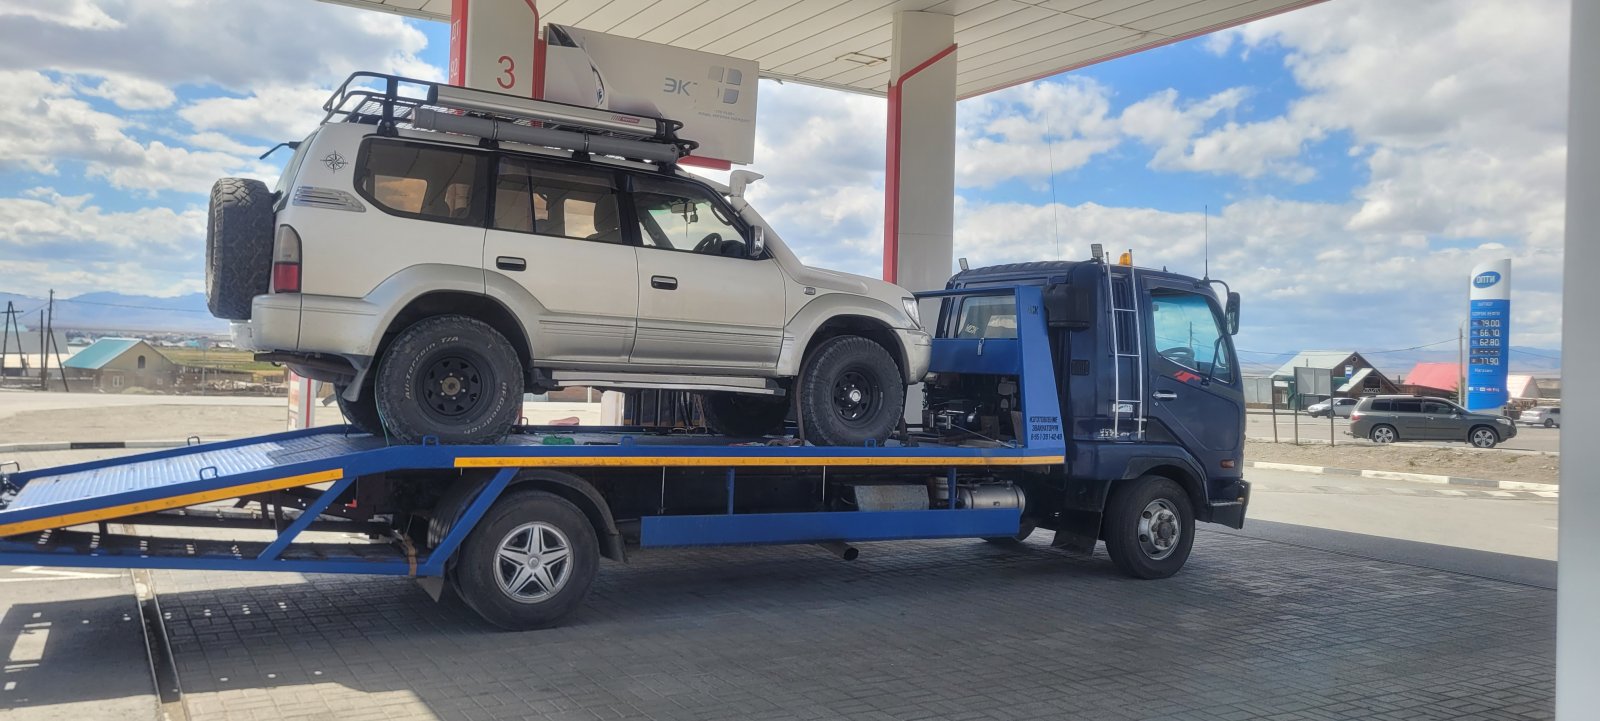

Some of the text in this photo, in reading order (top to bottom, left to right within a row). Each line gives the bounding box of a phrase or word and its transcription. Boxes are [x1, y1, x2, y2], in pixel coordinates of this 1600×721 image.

[496, 55, 516, 90] 3
[1476, 275, 1496, 284] ОПТИ
[1479, 329, 1500, 337] 66.10
[1479, 338, 1500, 346] 62.80
